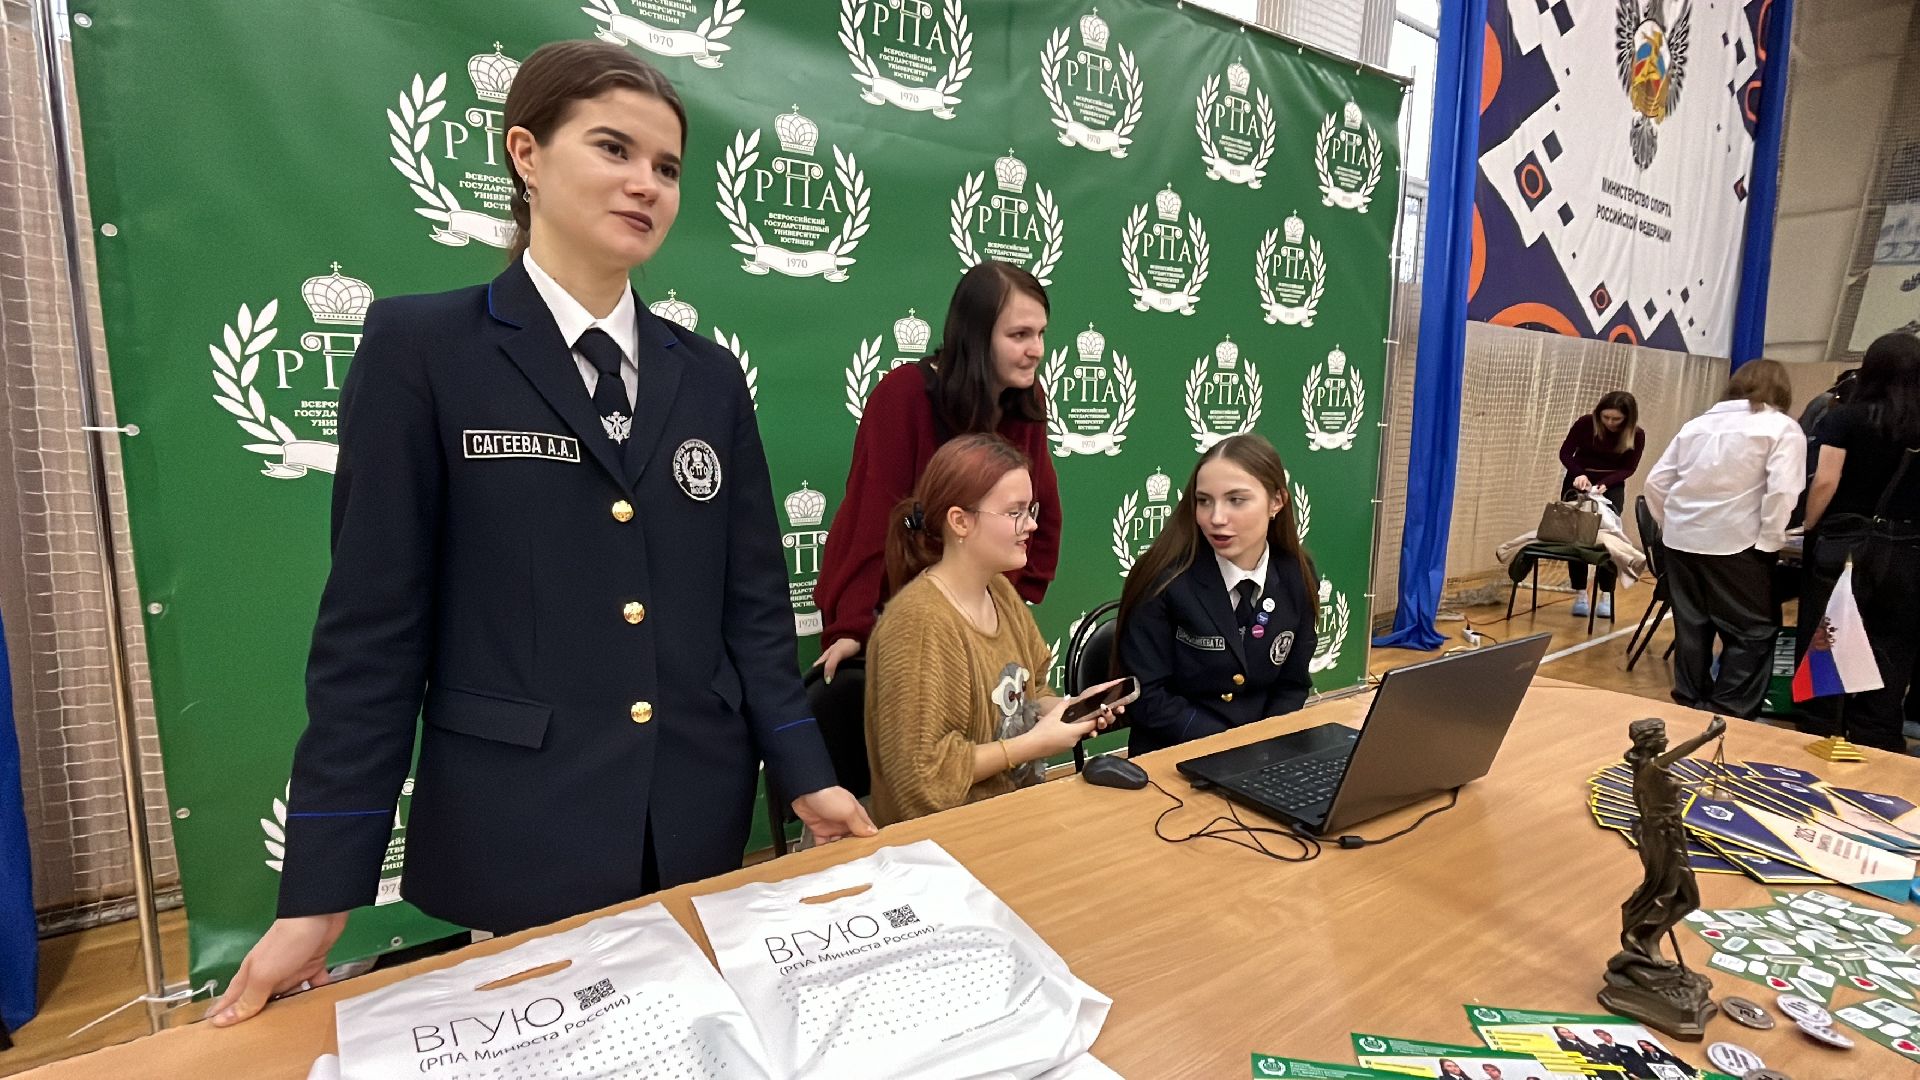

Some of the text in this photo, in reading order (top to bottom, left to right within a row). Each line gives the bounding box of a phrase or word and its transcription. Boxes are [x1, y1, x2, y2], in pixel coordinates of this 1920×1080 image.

[649, 33, 674, 48] 1970
[1066, 51, 1124, 100] РПА
[900, 91, 919, 103] 1970
[1215, 95, 1260, 138] РПА
[1331, 130, 1368, 168] РПА
[754, 157, 842, 213] РПА
[1601, 177, 1671, 218] МИНИСТЕРСТВО СПОРТА
[764, 219, 829, 233] ГОСУДАРСТВЕННЫЙ
[769, 213, 825, 225] ВСЕРОССИЙСКИЙ
[774, 228, 820, 239] УНИВЕРСИТЕТ
[978, 195, 1041, 242] РПА
[1596, 203, 1672, 242] РОССИЙСКОЙ ФЕДЕРАЦИИ
[1143, 223, 1192, 264] РПА
[787, 258, 808, 268] 1970
[1272, 246, 1312, 281] РПА
[1063, 366, 1118, 403] РПА
[1204, 373, 1247, 405] РПА
[1316, 378, 1352, 408] РПА
[472, 434, 574, 458] САГЕЕВА А.А.
[1081, 440, 1095, 449] 1970
[799, 618, 819, 629] 1970
[765, 915, 880, 964] ВГУЮ
[779, 925, 935, 977] (РПА Минюста России)
[412, 997, 565, 1053] ВГУЮ
[419, 1052, 469, 1073] (РПА
[474, 1031, 560, 1062] Минюста
[564, 995, 631, 1034] России)
